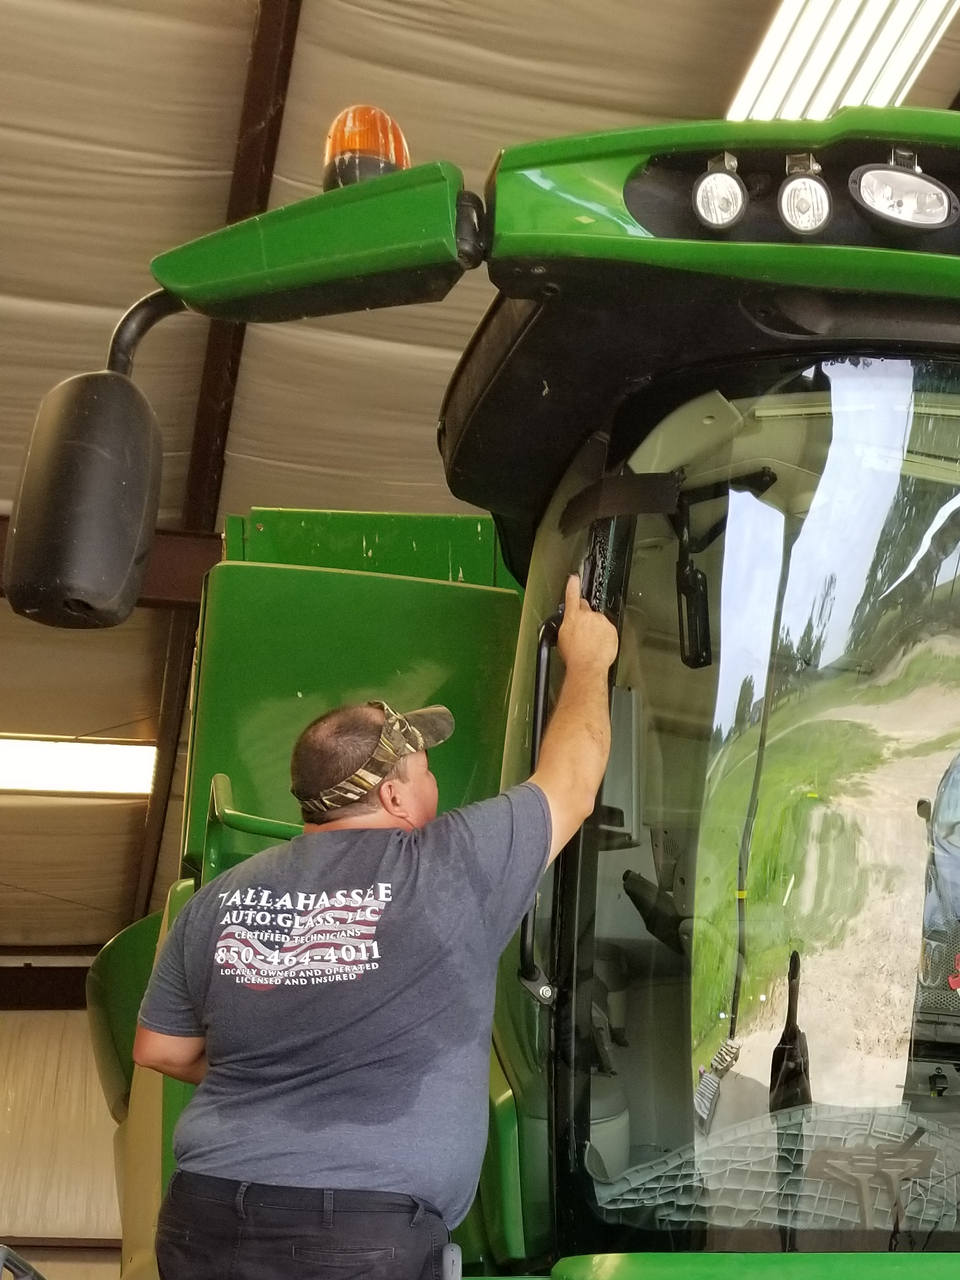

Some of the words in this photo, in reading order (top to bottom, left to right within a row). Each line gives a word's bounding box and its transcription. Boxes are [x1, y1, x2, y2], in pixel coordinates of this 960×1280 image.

[218, 882, 392, 911] TALLAHASSEE
[220, 910, 271, 925] AUTO
[277, 912, 340, 929] GLASS,
[346, 907, 380, 923] LLC
[235, 931, 290, 942] CERTIFIED
[293, 929, 361, 943] TECHNICIANS
[216, 942, 381, 966] 850-464-4011
[220, 968, 257, 977] LOCALLY
[260, 969, 296, 977] OWNED
[299, 969, 321, 977] AND
[325, 962, 379, 975] OPERATED
[236, 977, 282, 985] LICENSED
[284, 978, 307, 986] AND
[311, 973, 357, 985] INSURED
